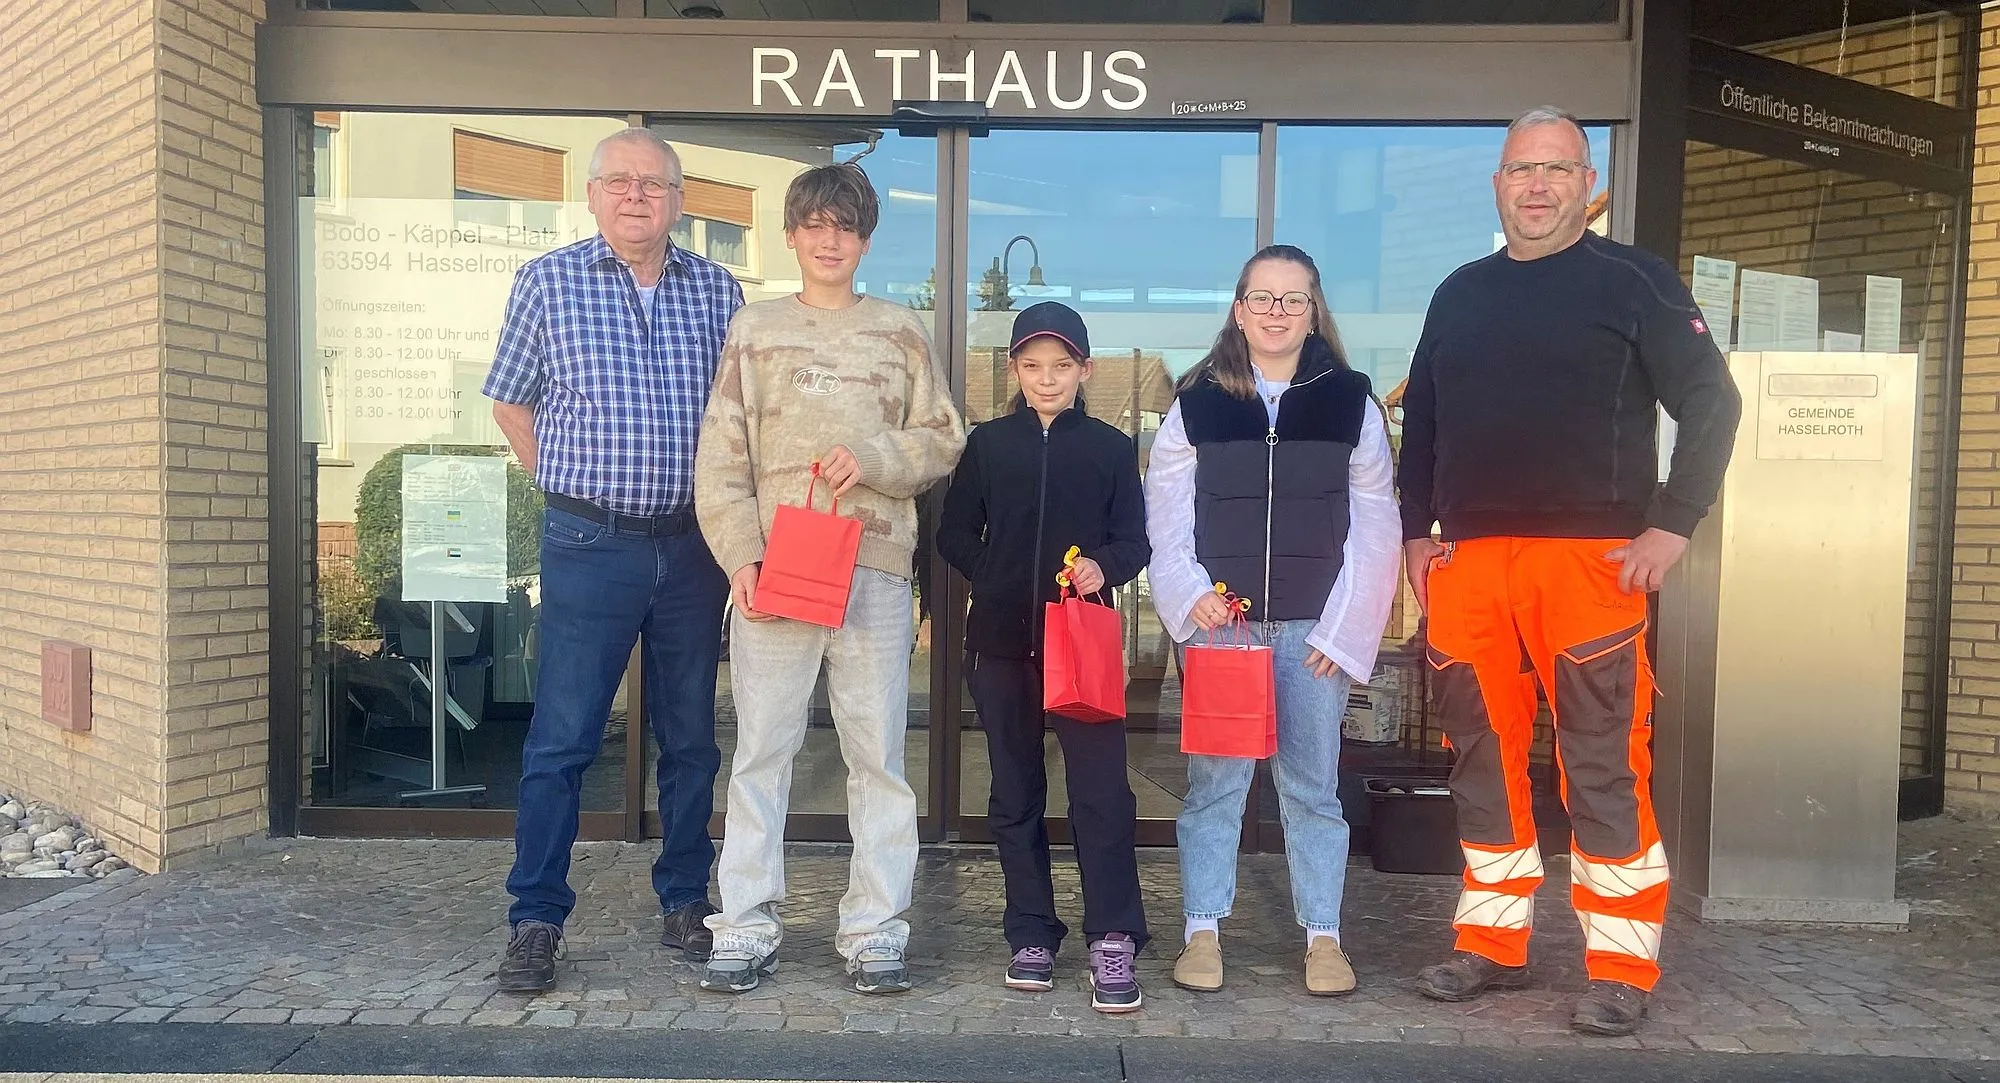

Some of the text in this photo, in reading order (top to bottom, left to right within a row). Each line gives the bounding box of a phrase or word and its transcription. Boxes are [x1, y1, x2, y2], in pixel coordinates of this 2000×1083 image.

[752, 47, 1148, 110] RATHAUS
[1720, 80, 1933, 157] Öffentliche Bekanntmachungen
[322, 222, 380, 242] Bodo
[404, 223, 482, 248] Käppel
[505, 225, 560, 246] Platz
[322, 251, 391, 271] 63594
[323, 298, 426, 314] Öffnungszeiten:
[354, 327, 383, 339] 8.30
[397, 328, 433, 340] 12.00
[438, 328, 461, 341] Uhr
[465, 329, 489, 341] und
[354, 347, 383, 359] 8.30
[397, 348, 433, 360] 12.00
[438, 348, 462, 360] Uhr
[354, 367, 437, 381] geschlossen
[355, 387, 384, 399] 8.30
[398, 387, 433, 400] 12.00
[438, 388, 462, 400] Uhr
[355, 406, 384, 418] 8.30
[398, 407, 434, 419] 12.00
[438, 407, 462, 420] Uhr
[1788, 407, 1855, 419] GEMEINDE
[1778, 424, 1863, 436] HASSELROTH
